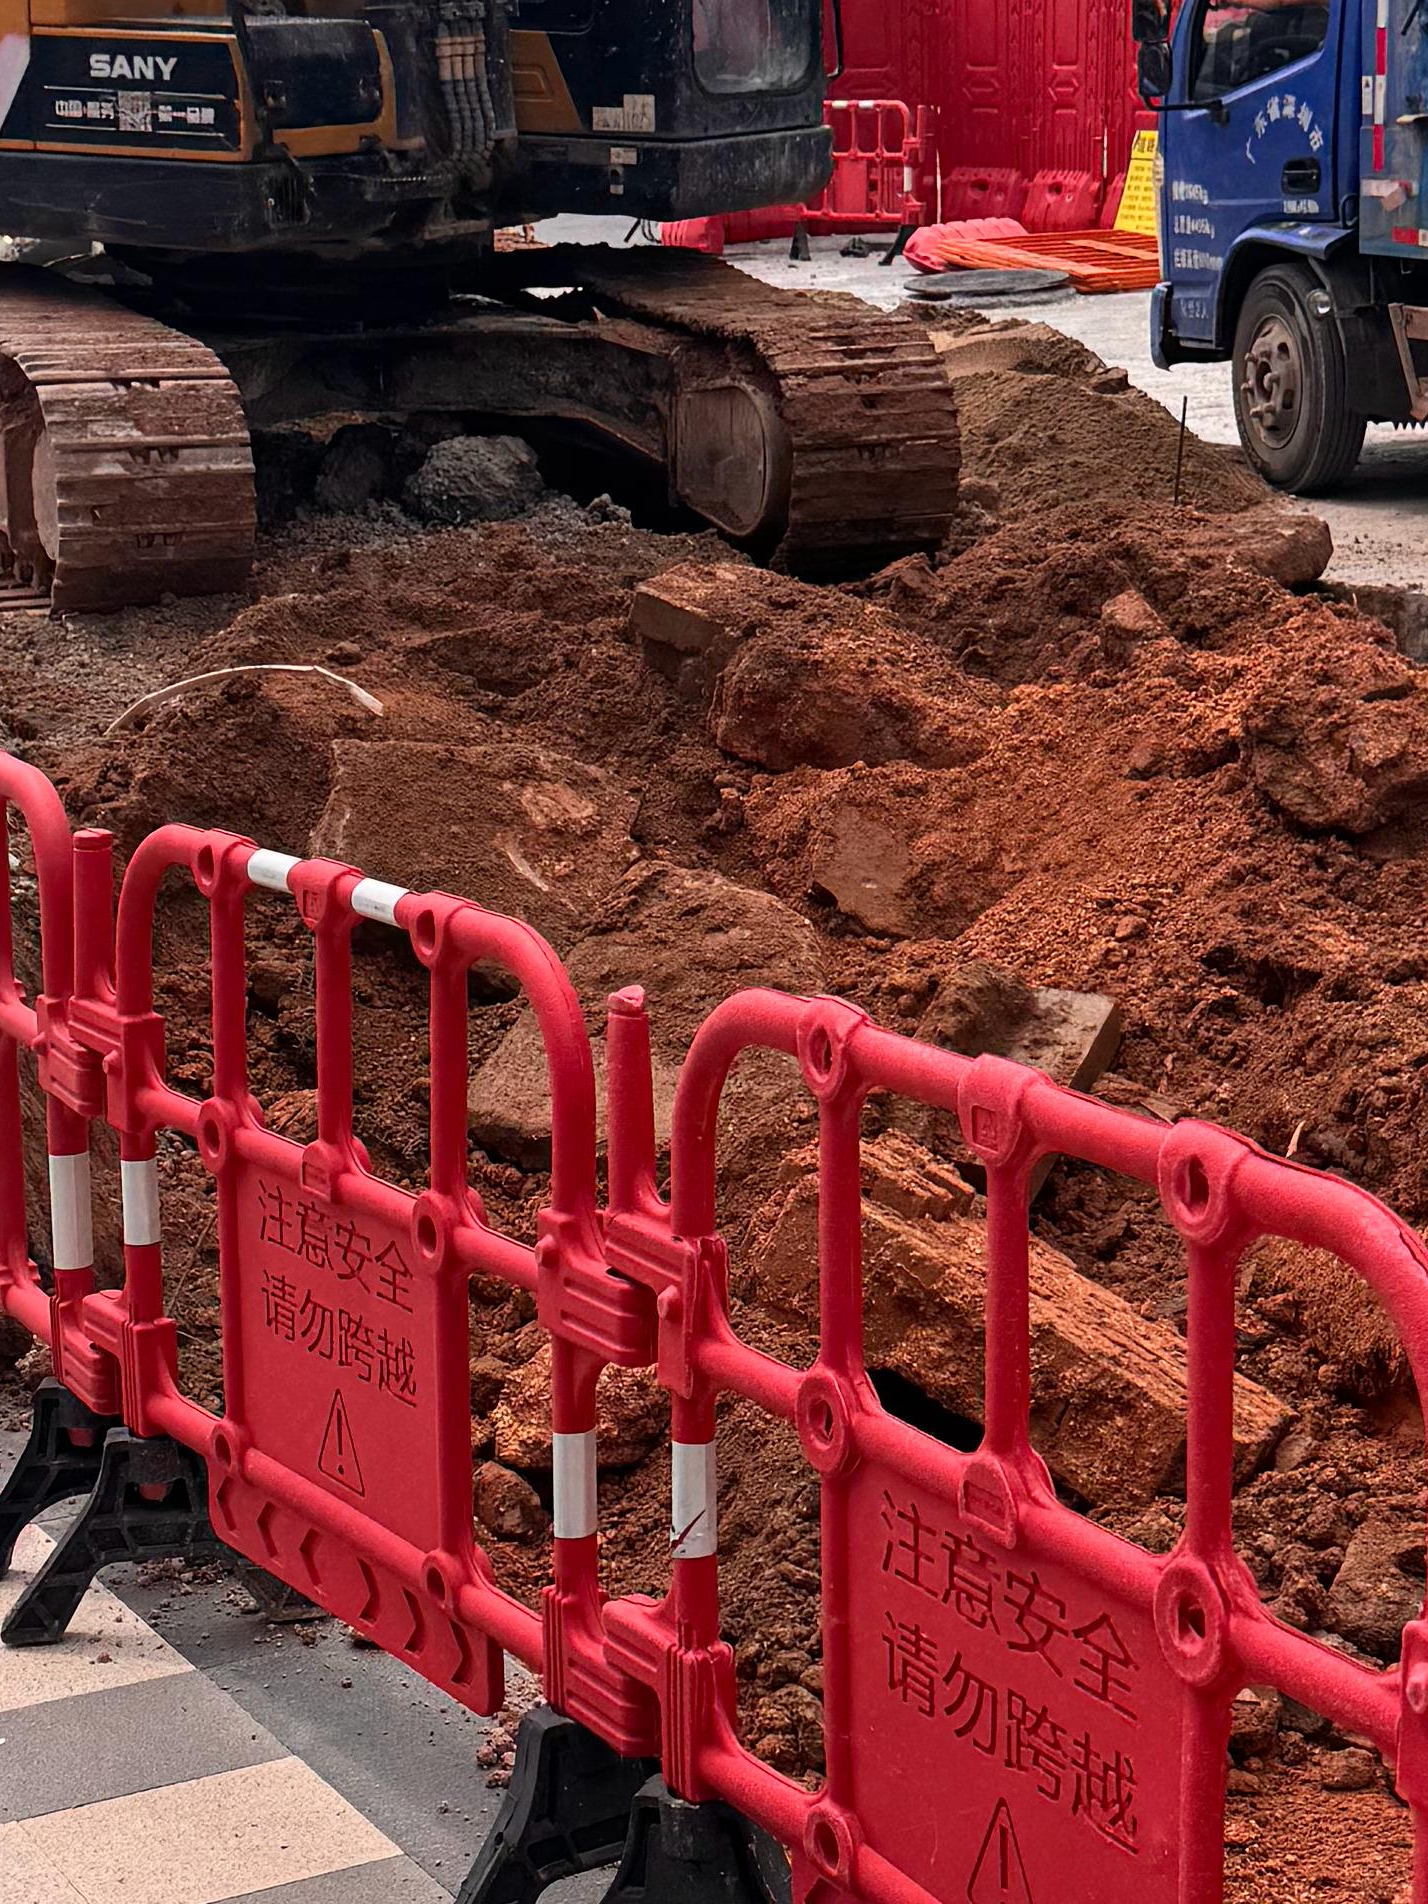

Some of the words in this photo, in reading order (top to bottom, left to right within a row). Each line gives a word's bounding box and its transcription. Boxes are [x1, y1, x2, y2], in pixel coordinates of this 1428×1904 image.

[89, 53, 178, 81] SANY
[256, 1178, 416, 1316] 注意安全
[260, 1268, 419, 1409] 请勿跨越
[879, 1486, 1142, 1724] 注意安全
[883, 1610, 1142, 1856] 请勿跨越
